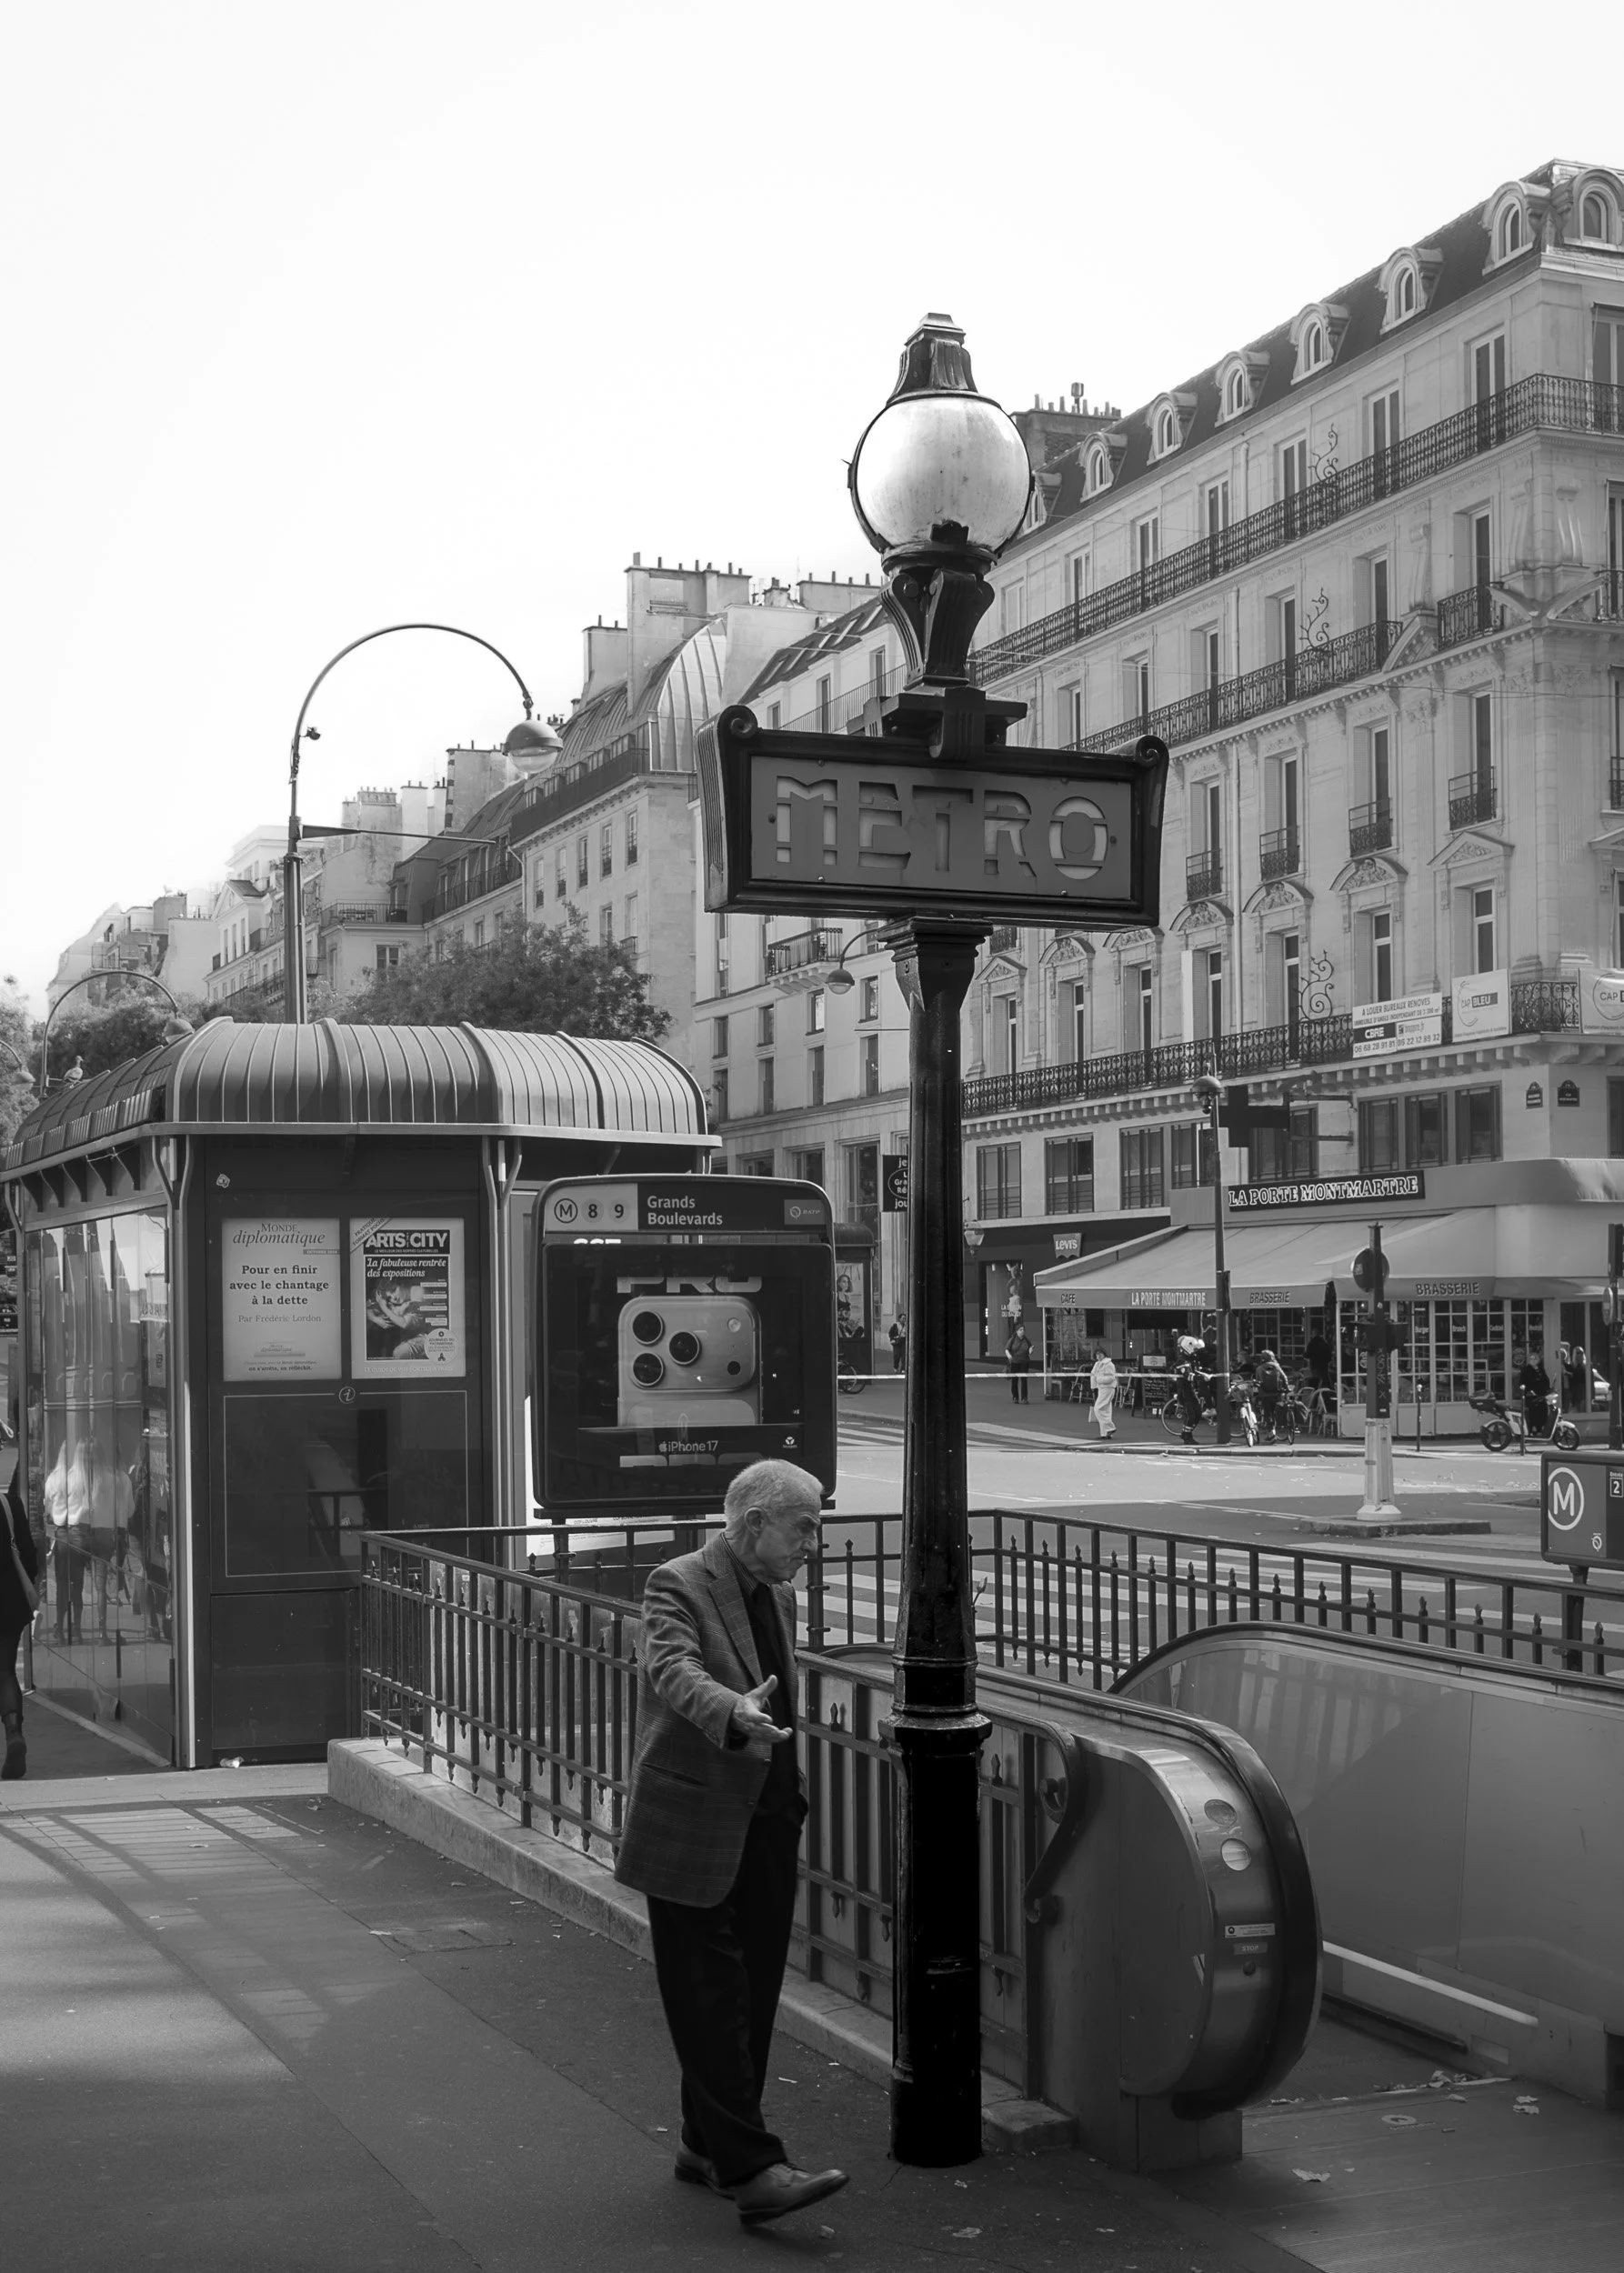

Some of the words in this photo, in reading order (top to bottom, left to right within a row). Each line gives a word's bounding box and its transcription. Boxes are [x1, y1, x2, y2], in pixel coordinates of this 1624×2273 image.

[777, 775, 1108, 880] METRO
[1472, 995, 1491, 1007] BLEU
[1599, 991, 1619, 1001] CAP
[1366, 1005, 1382, 1016] LOUER
[1383, 1002, 1407, 1013] BUREAUX
[1365, 1026, 1385, 1038] CBRE
[1228, 1189, 1248, 1207] LA
[1249, 1186, 1298, 1206] PORTE
[1300, 1176, 1418, 1202] MONTMARTRE
[647, 1196, 696, 1209] Grands
[587, 1203, 598, 1218] 8
[614, 1203, 625, 1218] 9
[647, 1212, 723, 1226] Boulevards
[233, 1229, 326, 1247] diplomatique
[365, 1232, 406, 1248] ARTS
[409, 1232, 448, 1248] CITY
[241, 1265, 270, 1275] Pour
[274, 1267, 287, 1275] en
[292, 1265, 318, 1275] finir
[366, 1257, 378, 1267] La
[377, 1257, 418, 1270] fabuleuse
[418, 1258, 446, 1267] rentrée
[366, 1268, 381, 1277] des
[382, 1269, 426, 1280] expositions
[229, 1282, 257, 1290] avec
[261, 1280, 272, 1290] le
[275, 1280, 329, 1292] chantage
[1415, 1281, 1480, 1296] BRASSERIE
[252, 1295, 259, 1305] à
[263, 1295, 273, 1305] la
[276, 1295, 308, 1305] dette
[1131, 1292, 1141, 1307] LA
[1141, 1292, 1159, 1307] PORTE
[1161, 1291, 1207, 1307] MONTMARTRE
[1249, 1290, 1290, 1306] BRASSERIE
[238, 1315, 254, 1323] Par
[256, 1314, 291, 1323] Frédéric
[292, 1314, 322, 1323] Lordon
[667, 1440, 706, 1453] iPhone
[707, 1440, 718, 1452] 17
[1613, 1480, 1620, 1494] 2
